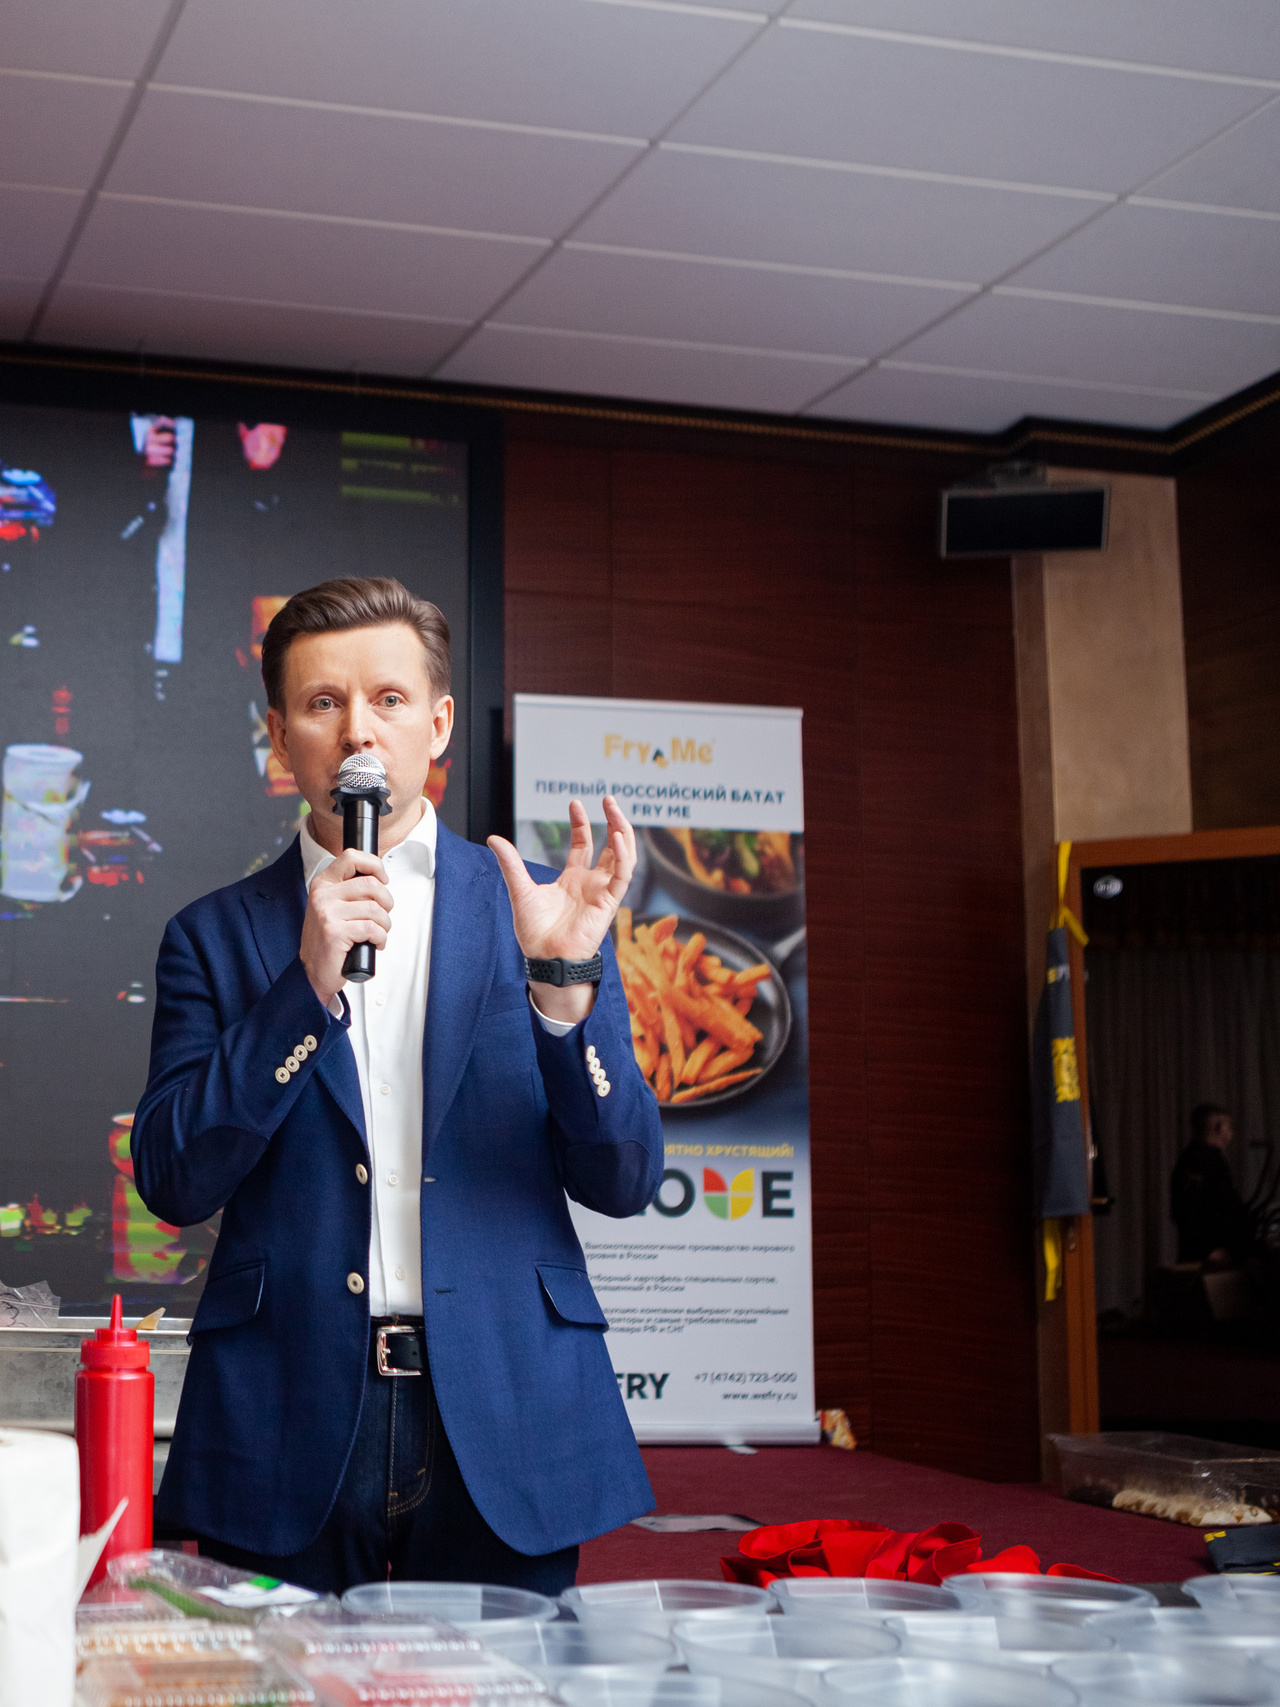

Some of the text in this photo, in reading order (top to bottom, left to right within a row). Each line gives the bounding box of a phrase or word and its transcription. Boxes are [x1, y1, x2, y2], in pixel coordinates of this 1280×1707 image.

[604, 734, 714, 764] Fry Me
[536, 779, 785, 804] ПЕРВЫЙ РОССИЙСКИЙ БАТАТ
[632, 804, 691, 819] FRY ME
[627, 1251, 659, 1260] России
[589, 1274, 632, 1282] тборный
[653, 1284, 686, 1292] России
[694, 1372, 708, 1382] +7
[710, 1371, 747, 1385] (4742)
